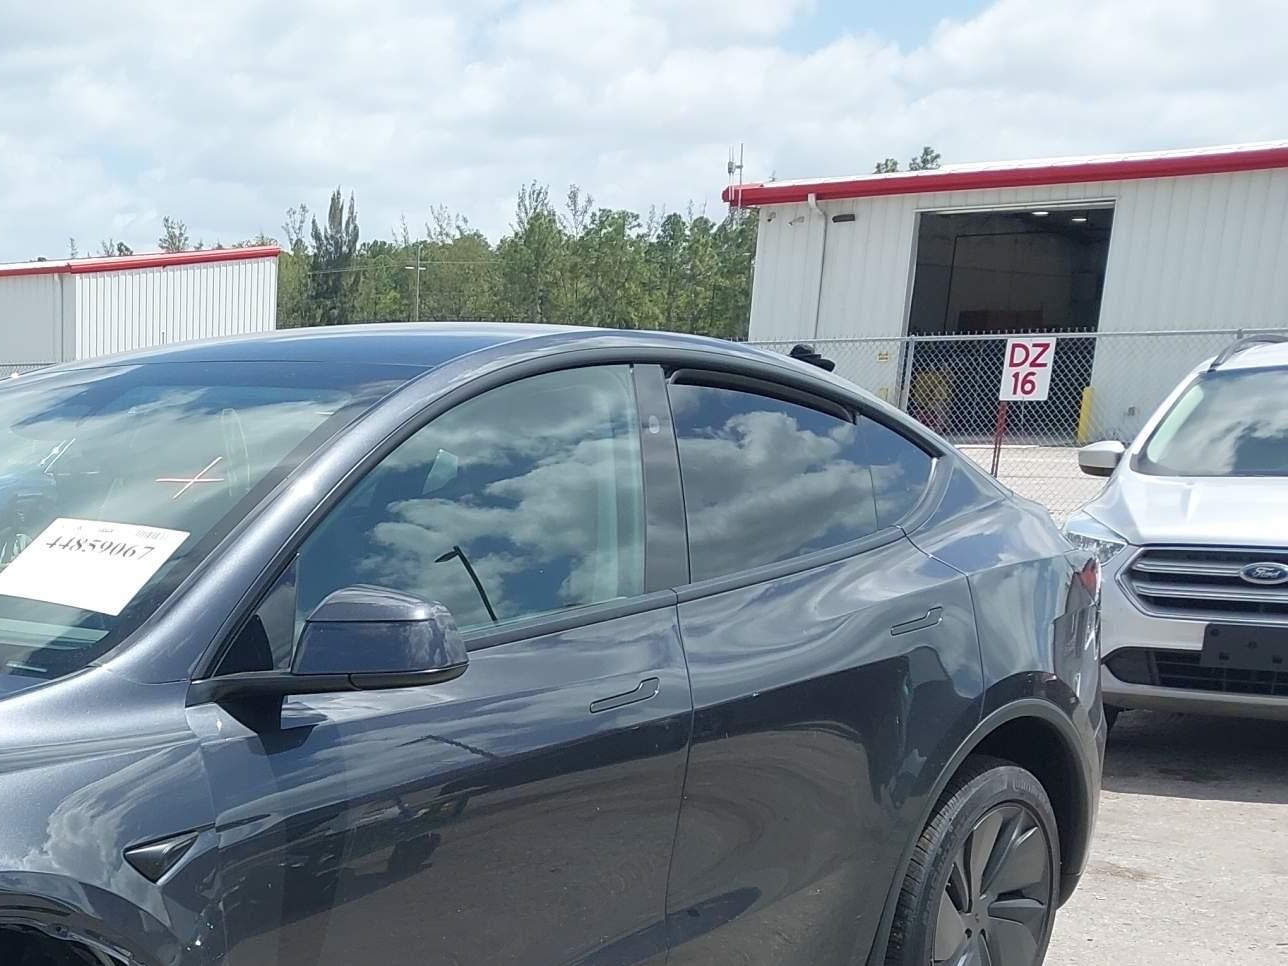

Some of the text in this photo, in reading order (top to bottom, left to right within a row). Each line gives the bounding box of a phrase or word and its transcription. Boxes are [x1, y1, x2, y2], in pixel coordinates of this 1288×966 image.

[1009, 343, 1050, 367] DZ
[1012, 371, 1037, 395] 16
[45, 535, 155, 560] 44859067
[1252, 566, 1281, 579] Ford
